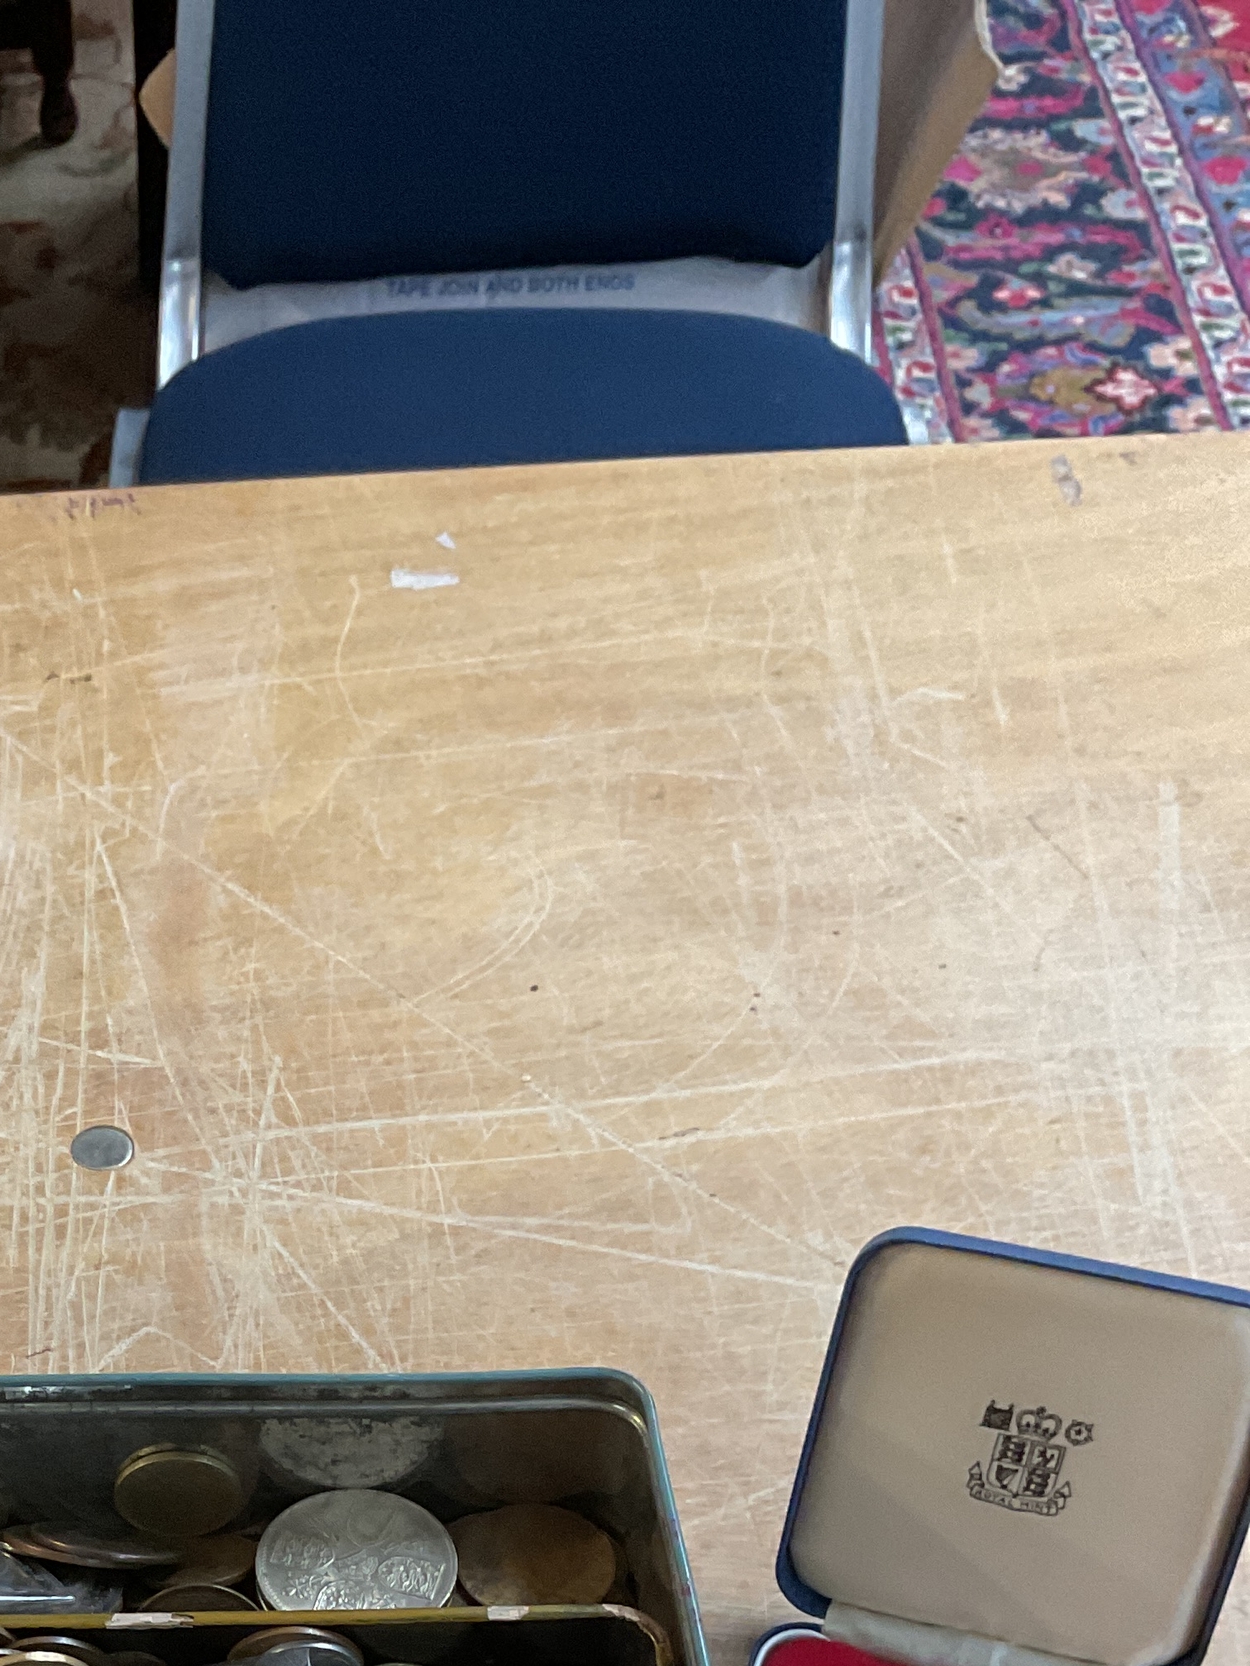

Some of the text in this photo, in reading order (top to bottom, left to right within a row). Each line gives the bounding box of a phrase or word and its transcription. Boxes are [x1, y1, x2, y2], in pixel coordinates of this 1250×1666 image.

[387, 276, 433, 298] TAPE
[438, 275, 480, 297] JOIN
[528, 272, 580, 292] BOTH
[585, 272, 636, 291] ENDS
